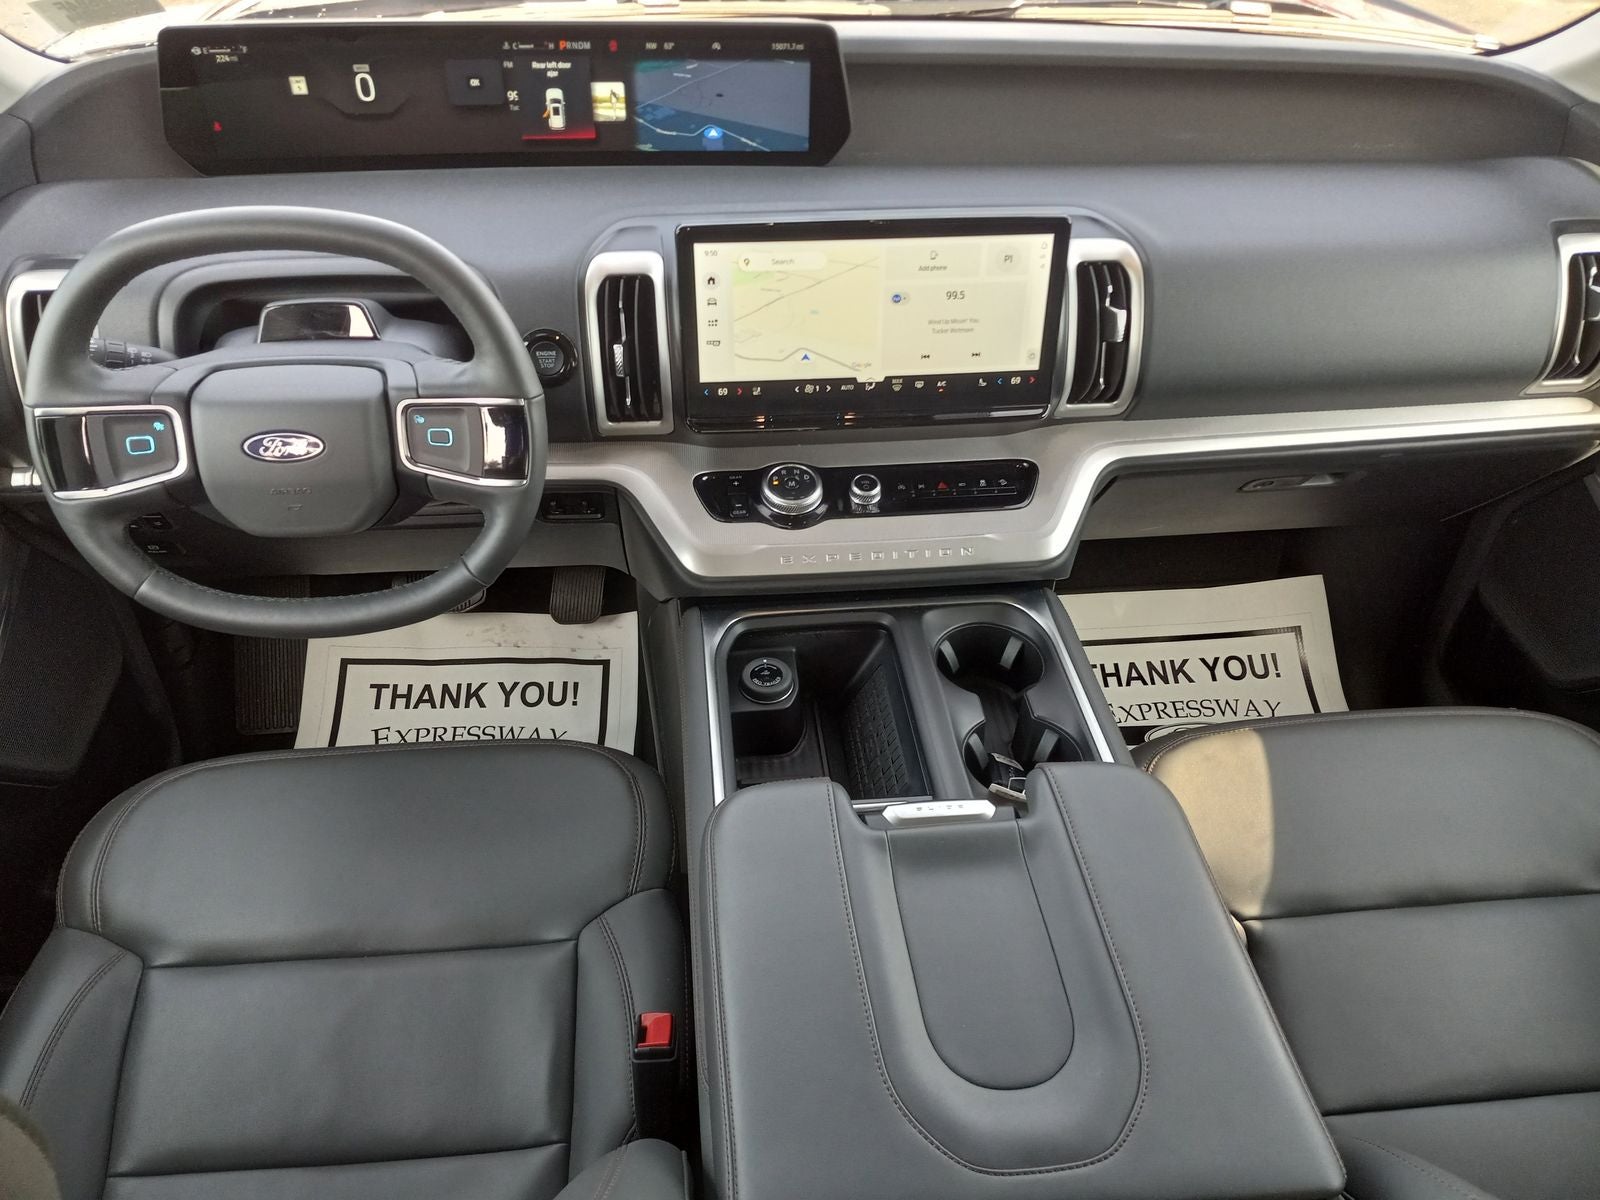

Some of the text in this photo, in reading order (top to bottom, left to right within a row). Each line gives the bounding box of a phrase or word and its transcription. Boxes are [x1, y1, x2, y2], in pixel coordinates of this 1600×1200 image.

[355, 73, 376, 102] 0
[771, 258, 795, 266] Search
[930, 264, 948, 273] phone
[945, 290, 966, 301] 99.5
[1010, 376, 1022, 385] 69
[717, 387, 729, 396] 69
[780, 546, 975, 565] EXPEDITION
[1090, 652, 1282, 688] HANK YOU!
[369, 681, 580, 710] THANK YOU!
